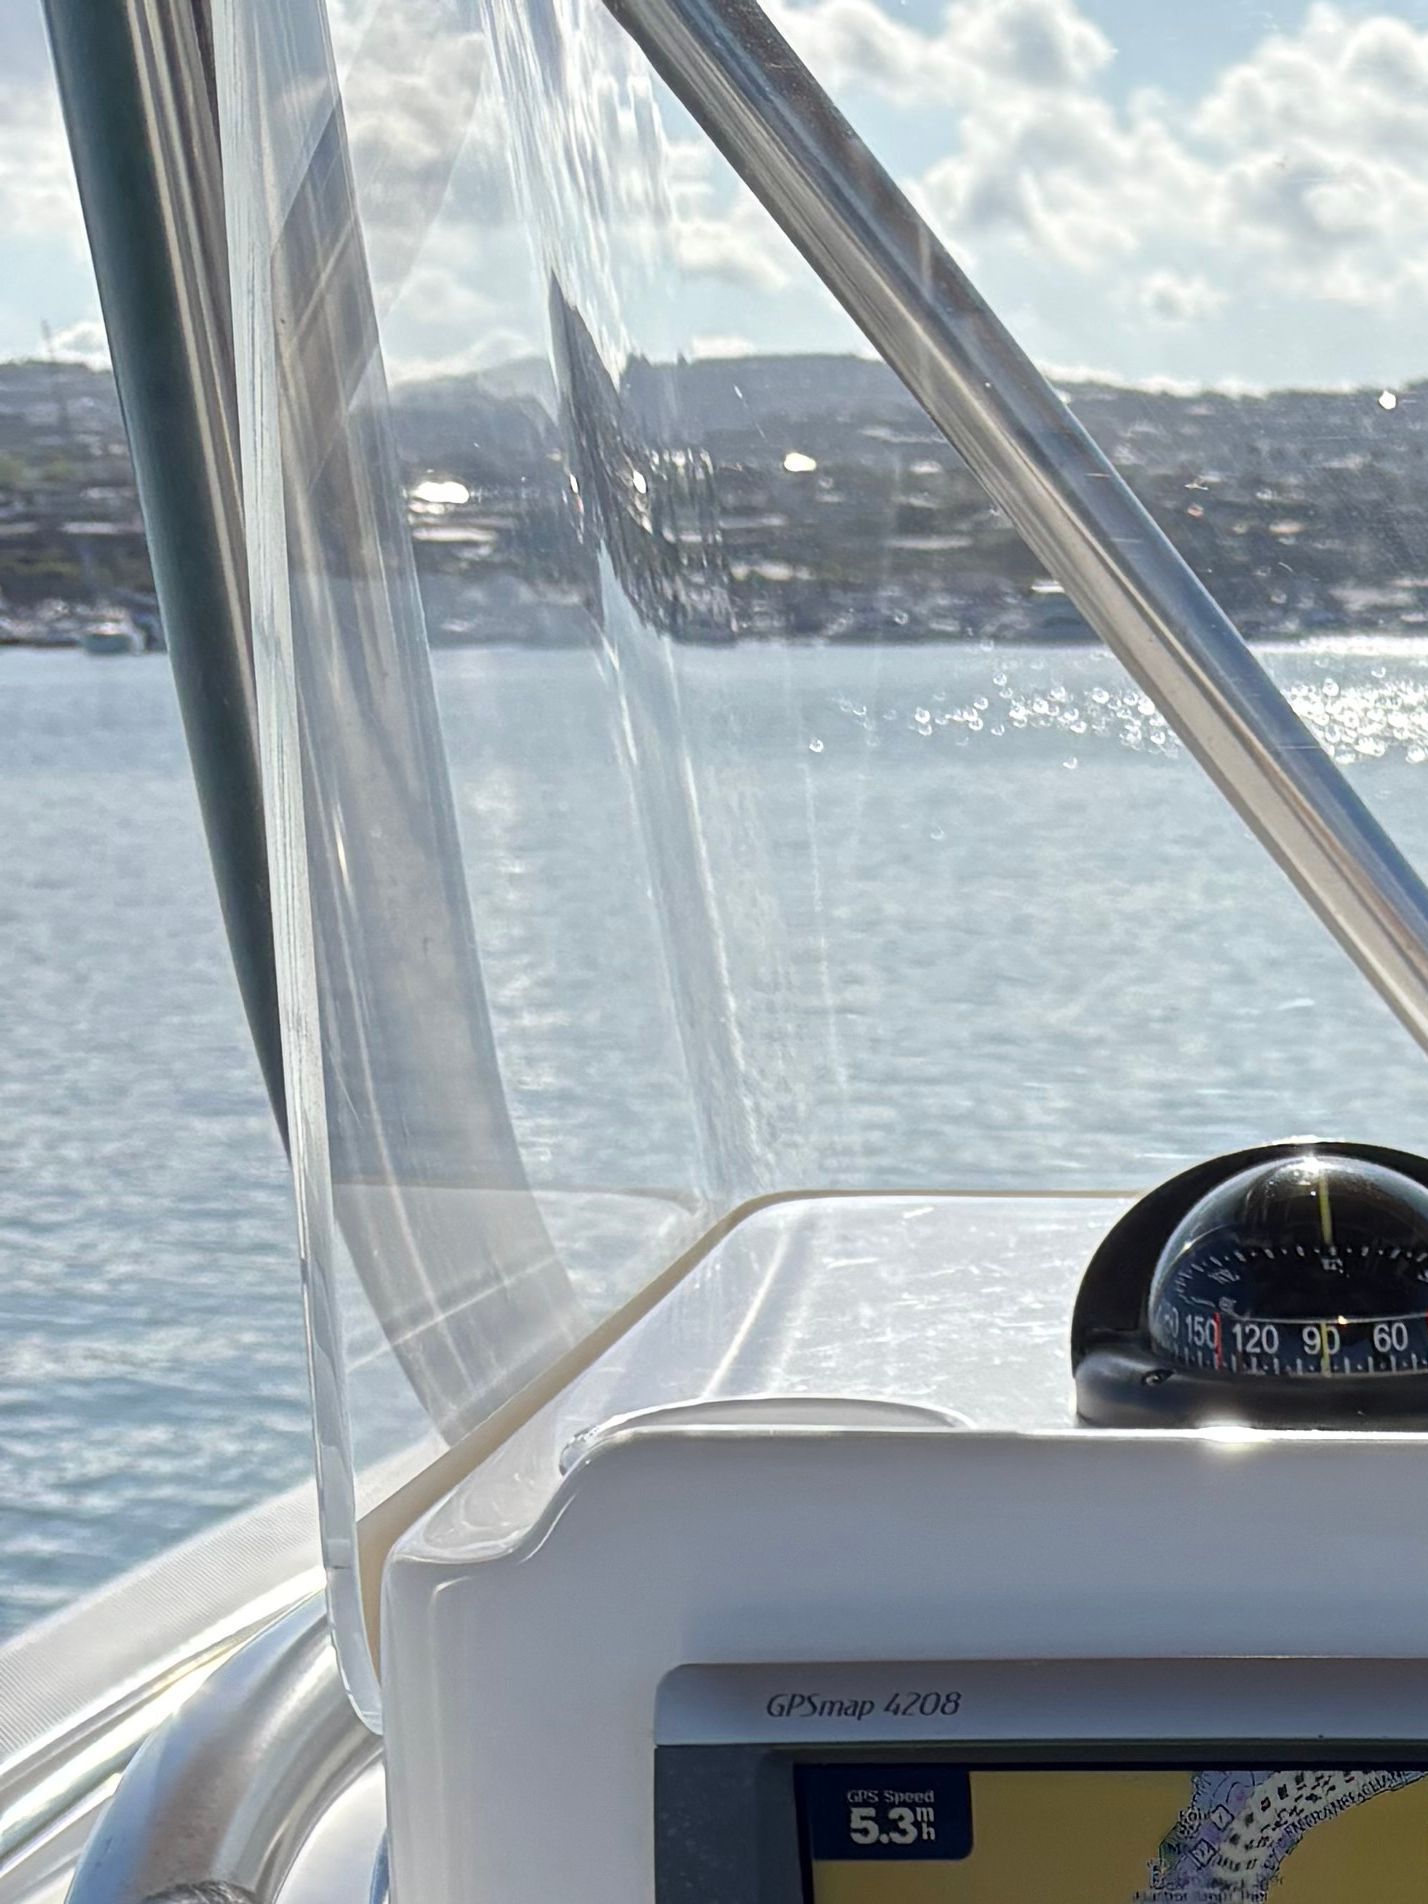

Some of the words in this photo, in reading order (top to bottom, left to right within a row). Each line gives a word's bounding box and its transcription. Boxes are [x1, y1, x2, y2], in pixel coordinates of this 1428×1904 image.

[1185, 1314, 1216, 1350] 150
[1233, 1324, 1280, 1355] 120
[1302, 1324, 1340, 1356] 90
[1372, 1322, 1409, 1354] 60
[765, 1690, 874, 1722] GPSmap
[882, 1688, 961, 1719] 4208
[883, 1789, 935, 1805] Speed
